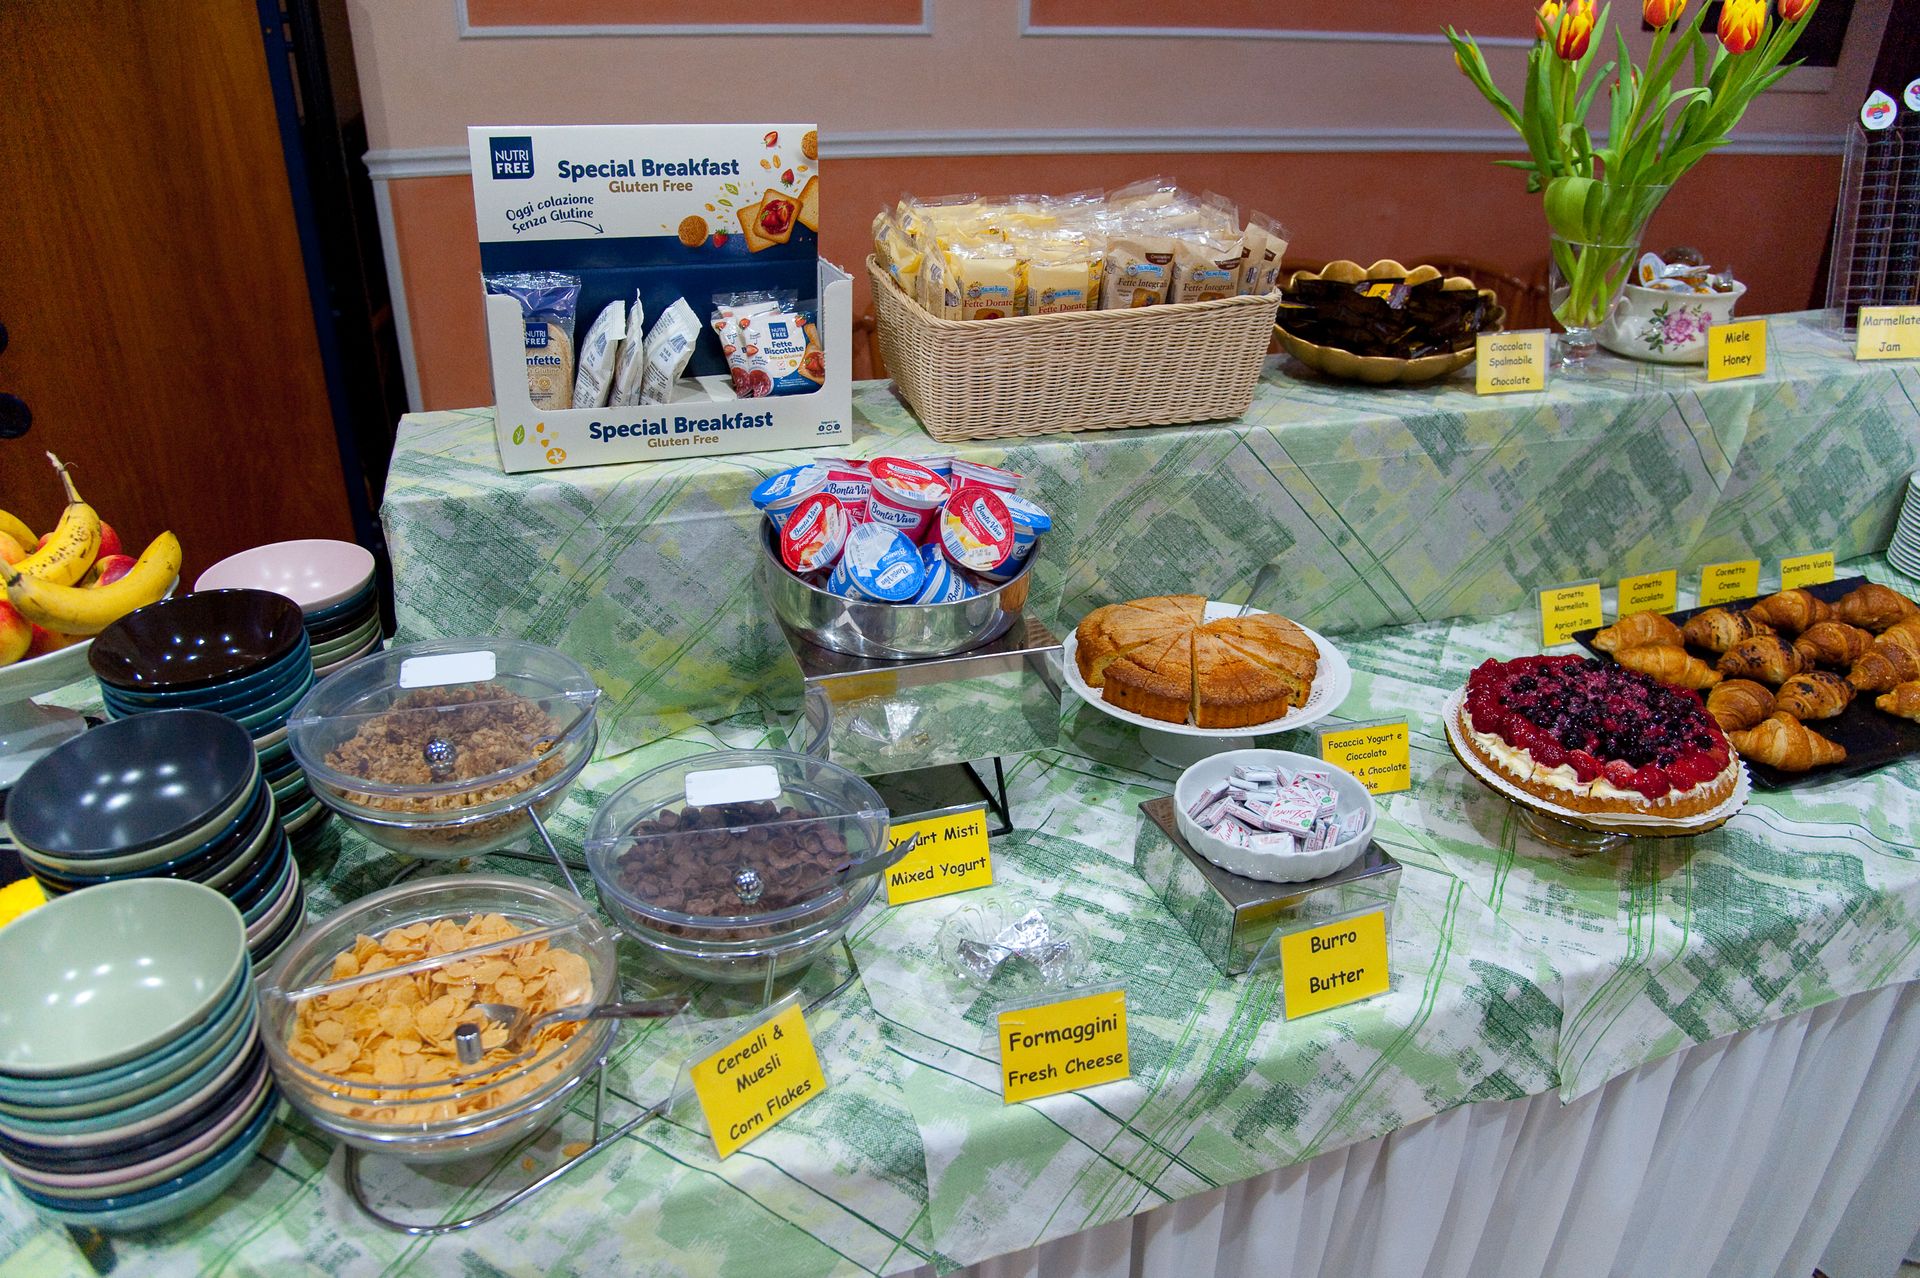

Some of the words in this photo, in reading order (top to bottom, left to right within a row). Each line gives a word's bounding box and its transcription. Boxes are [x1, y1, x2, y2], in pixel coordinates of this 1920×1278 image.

[494, 150, 529, 162] NUTRI
[496, 162, 530, 174] FREE
[558, 160, 636, 182] Special
[641, 158, 740, 177] Breakfast
[608, 180, 658, 193] Gluten
[662, 180, 693, 192] Free
[506, 202, 534, 222] Oggi
[537, 194, 594, 210] colazione
[512, 215, 548, 234] Senza
[550, 207, 594, 222] Glutine
[1060, 303, 1086, 312] Dorate
[1863, 315, 1920, 326] Marmellate
[1724, 330, 1750, 344] Miele
[764, 346, 804, 354] Biscottate
[1879, 342, 1901, 352] Jam
[526, 356, 560, 365] nfette
[1489, 356, 1532, 368] Spalmabile
[1724, 354, 1752, 366] Honey
[1490, 376, 1530, 386] Chocolate
[589, 418, 668, 442] Special
[674, 411, 773, 434] Breakfast
[648, 436, 690, 448] Gluten
[694, 434, 719, 445] Free
[894, 513, 916, 523] Viva
[1716, 568, 1746, 576] Cornetto
[1783, 564, 1810, 574] Cornetto
[1633, 580, 1662, 590] Cornetto
[1719, 582, 1740, 590] Crema
[1558, 592, 1584, 600] Cornetto
[1631, 593, 1664, 604] Cioccolato
[1555, 621, 1576, 631] Apricot
[1328, 738, 1364, 749] Focaccia
[1366, 734, 1393, 745] Yogurt
[1346, 749, 1387, 761] Cioccolato
[1368, 764, 1406, 775] Chocolate
[1362, 781, 1378, 790] ake
[944, 823, 978, 841] Misti
[891, 866, 934, 887] Mixed
[940, 857, 986, 877] Yogurt
[1310, 931, 1357, 953] Burro
[1310, 968, 1364, 994] Butter
[1009, 1013, 1117, 1051] Formaggini
[716, 1033, 768, 1075] Cereali
[772, 1024, 784, 1040] &
[736, 1054, 782, 1093] Muesli
[1008, 1063, 1057, 1087] Fresh
[1065, 1053, 1123, 1074] Cheese
[730, 1112, 764, 1140] Corn
[766, 1078, 811, 1116] Flakes
